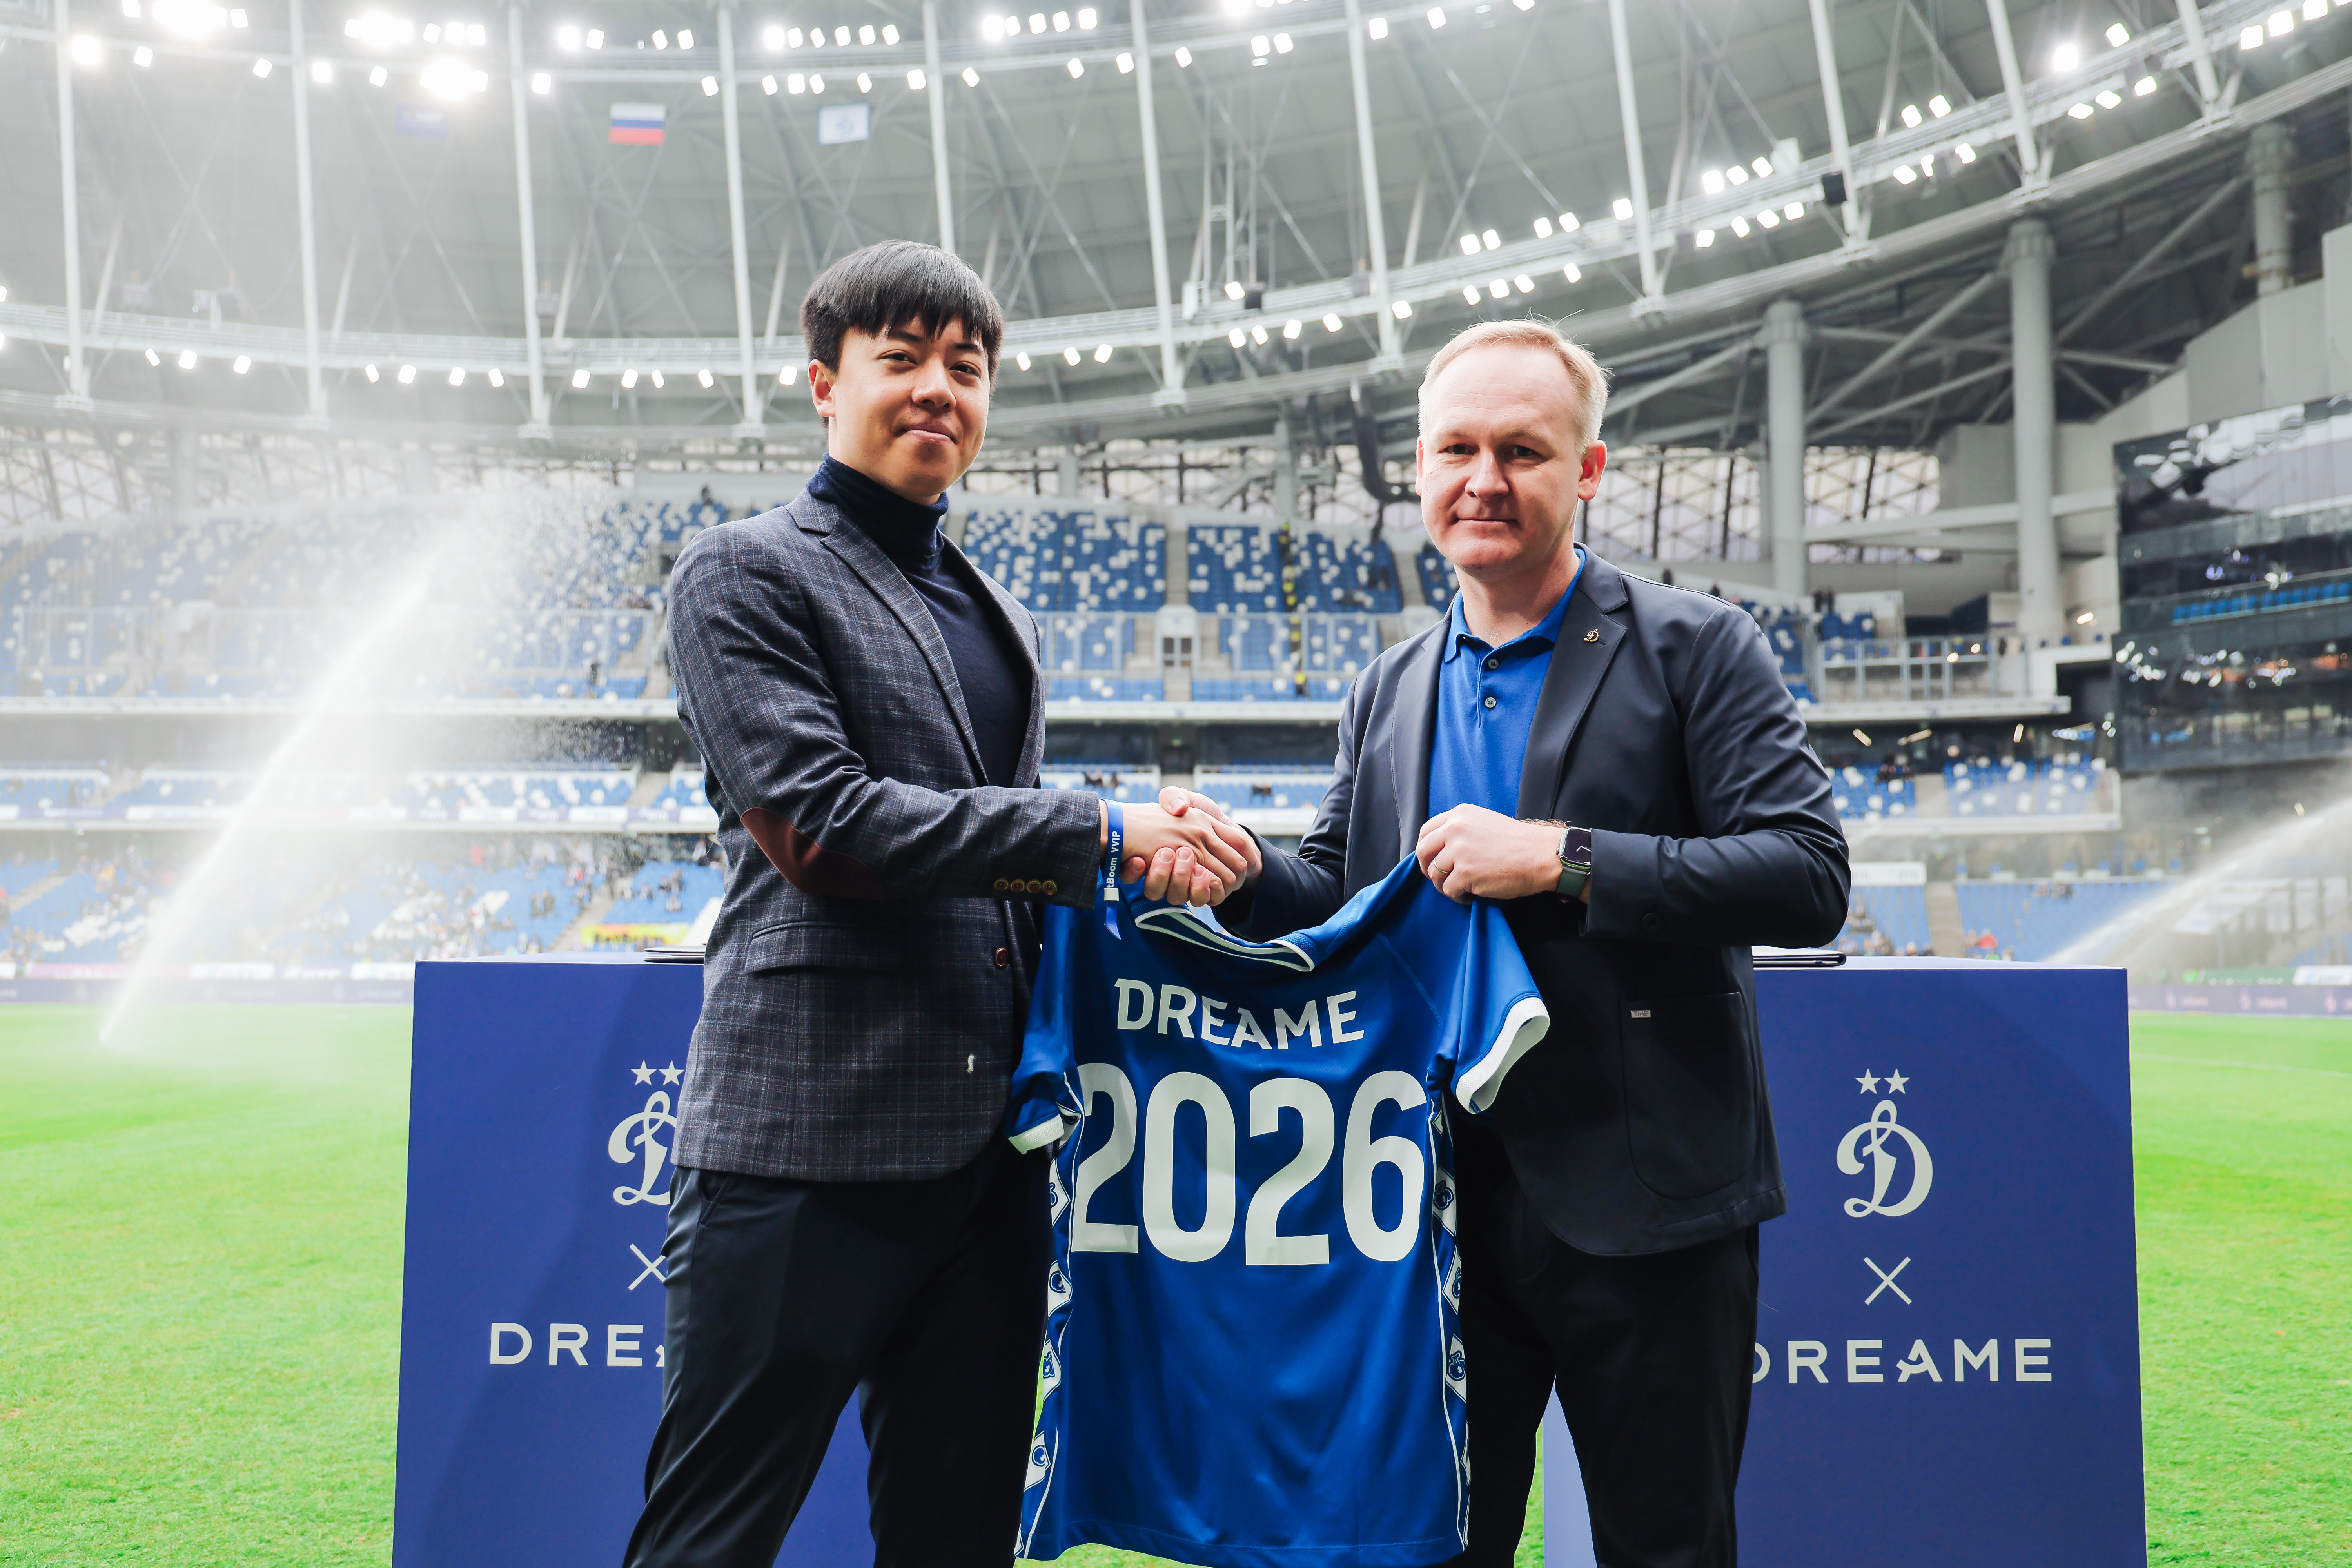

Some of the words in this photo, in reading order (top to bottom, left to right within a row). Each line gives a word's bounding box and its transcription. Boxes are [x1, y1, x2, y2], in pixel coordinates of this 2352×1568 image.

[1111, 831, 1120, 853] VVIP
[1114, 978, 1365, 1049] DREAME
[1071, 1063, 1427, 1265] 2026
[490, 1323, 664, 1367] DRE
